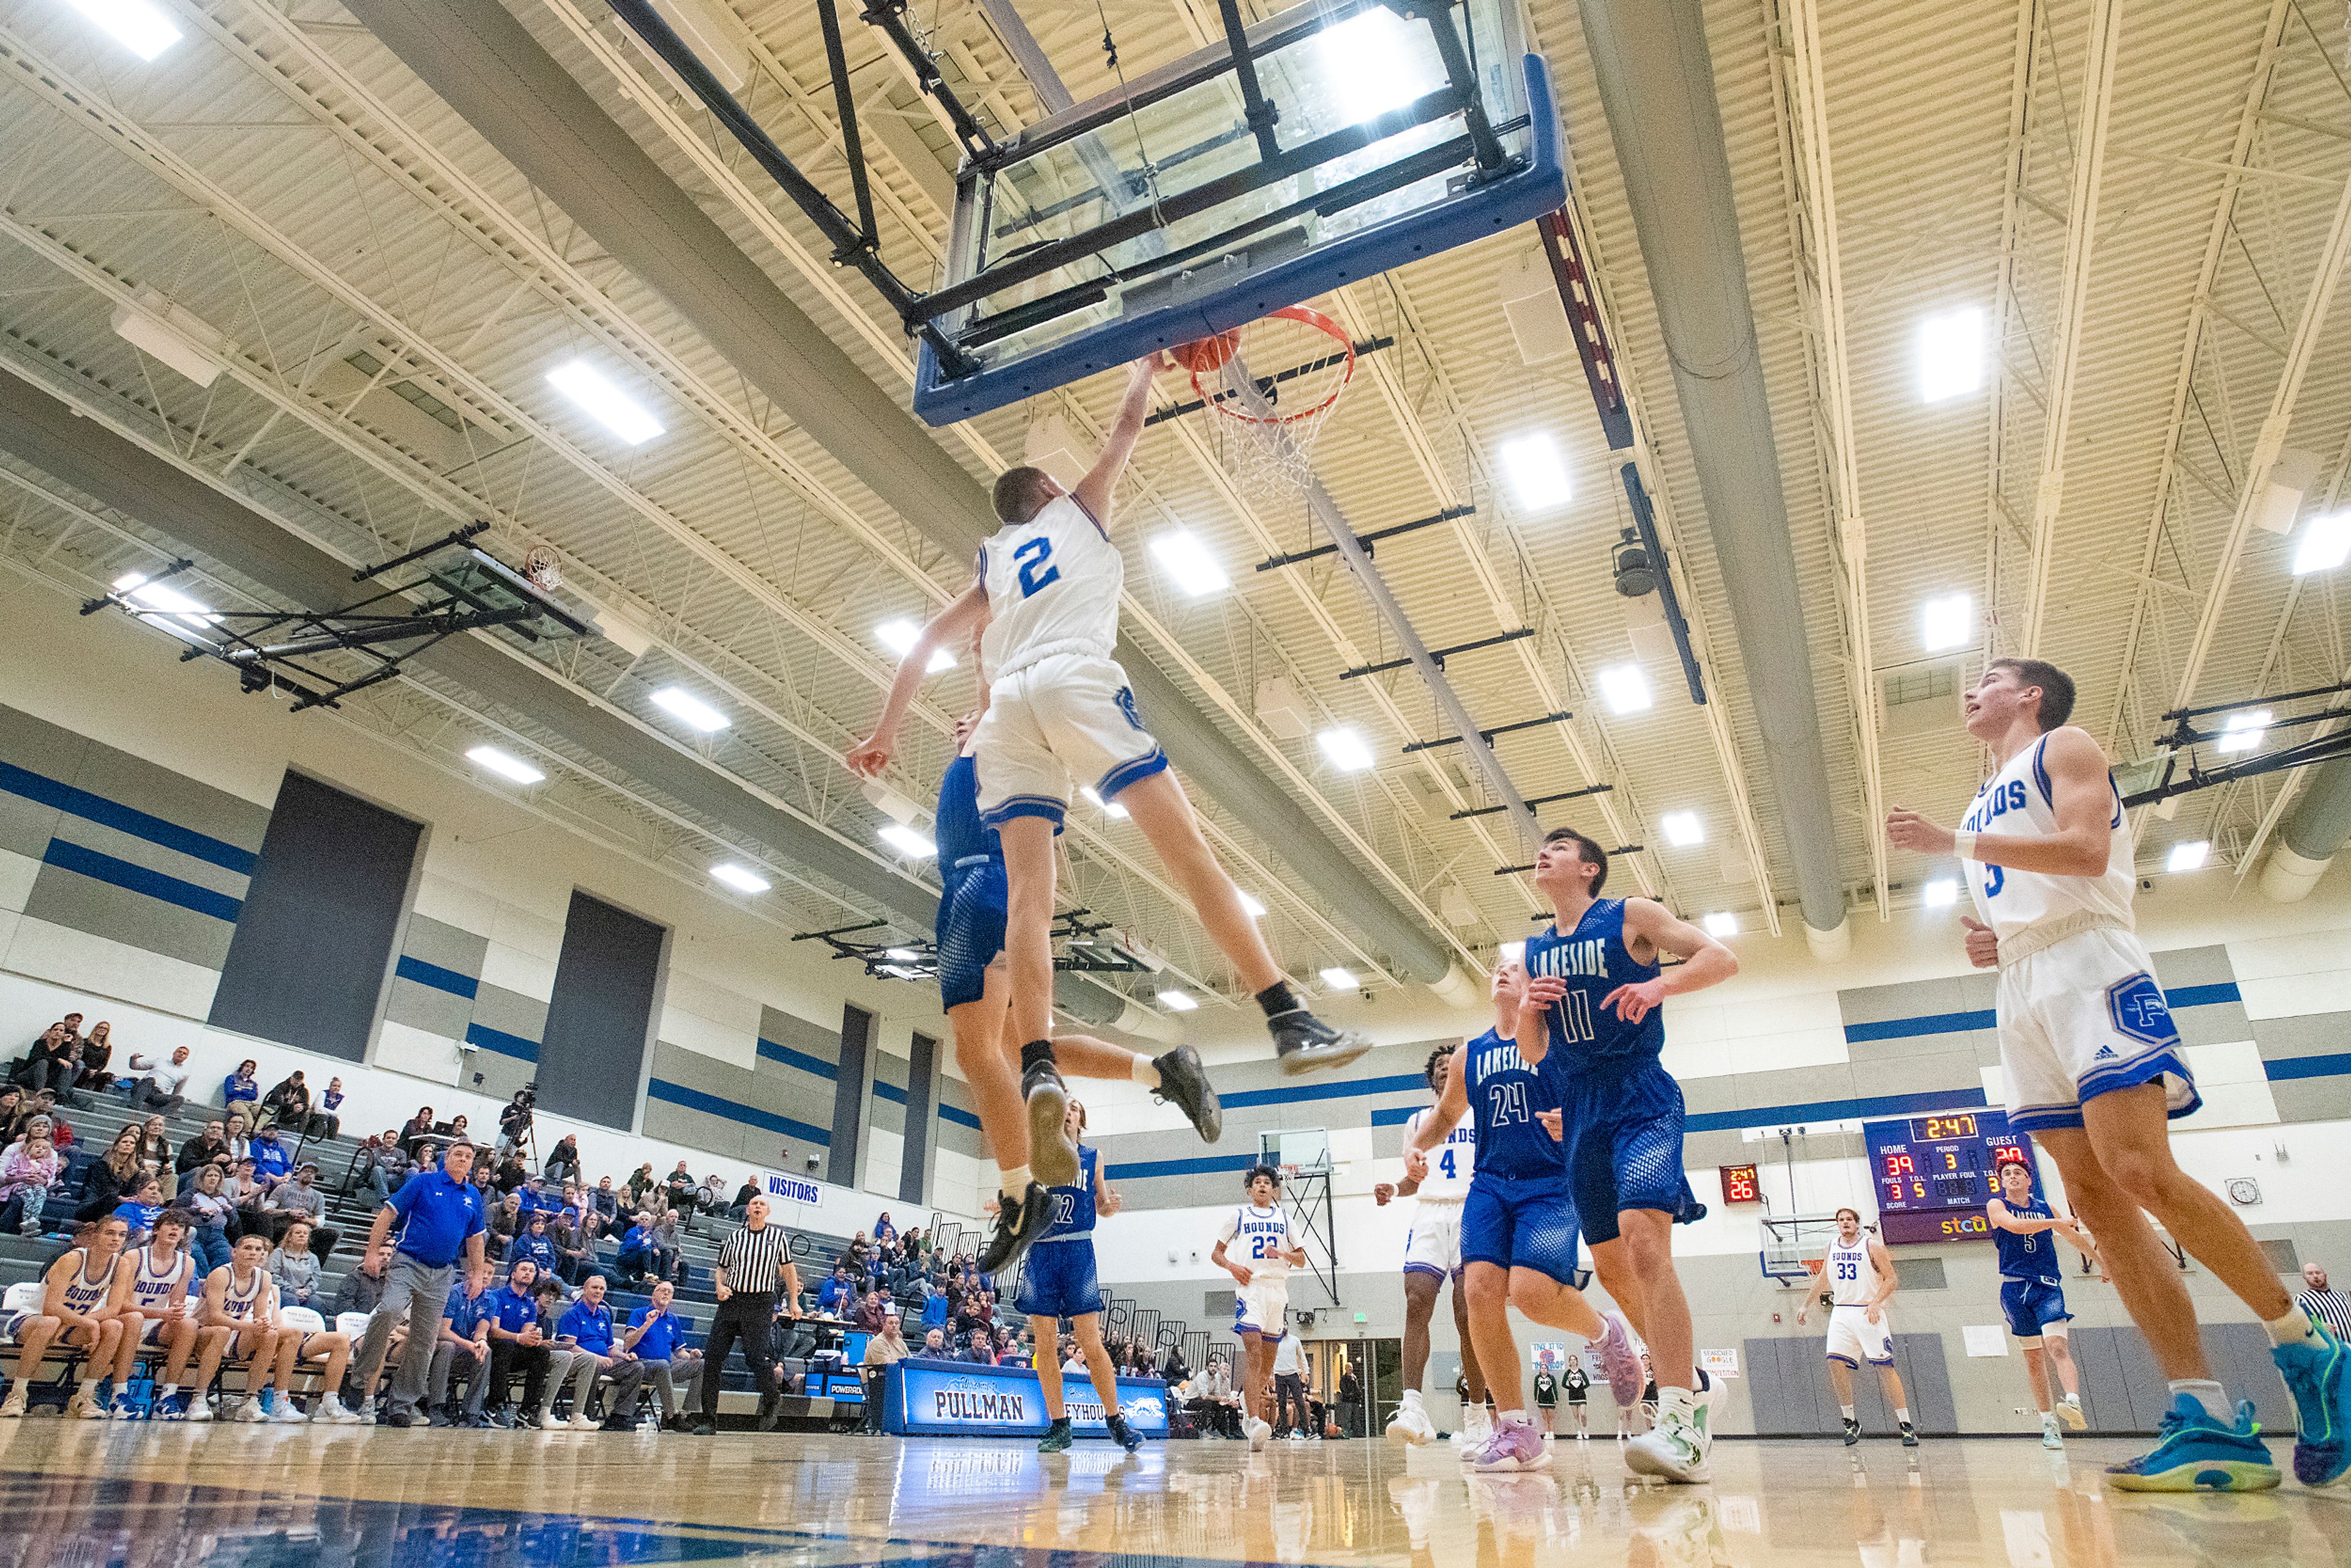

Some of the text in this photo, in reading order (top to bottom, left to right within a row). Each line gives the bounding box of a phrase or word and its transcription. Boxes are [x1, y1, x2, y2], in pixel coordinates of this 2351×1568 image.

[1013, 536, 1060, 599] 2
[1559, 989, 1594, 1043] 11
[1490, 1082, 1529, 1127] 24
[1442, 1128, 1475, 1144] NDS
[1927, 1116, 1974, 1139] 2:47
[1880, 1144, 1907, 1155] HOME
[1986, 1135, 2017, 1146] GUEST
[1439, 1149, 1457, 1179] 4
[1887, 1155, 1914, 1176] 39
[1945, 1153, 1957, 1170] 3
[1731, 1168, 1755, 1181] 2:47
[1933, 1172, 1957, 1180] PLAYER
[769, 1176, 819, 1203] VISITORS
[1731, 1180, 1753, 1199] 26
[1891, 1184, 1903, 1200] 3
[1913, 1182, 1925, 1198] 5
[1988, 1177, 2001, 1193] 3
[1243, 1222, 1284, 1234] HOUNDS
[1941, 1216, 1987, 1234] stcu
[2024, 1233, 2037, 1253] 5
[1832, 1252, 1862, 1261] HOUNDS
[1837, 1262, 1857, 1280] 33
[935, 1391, 1025, 1421] PULLMAN
